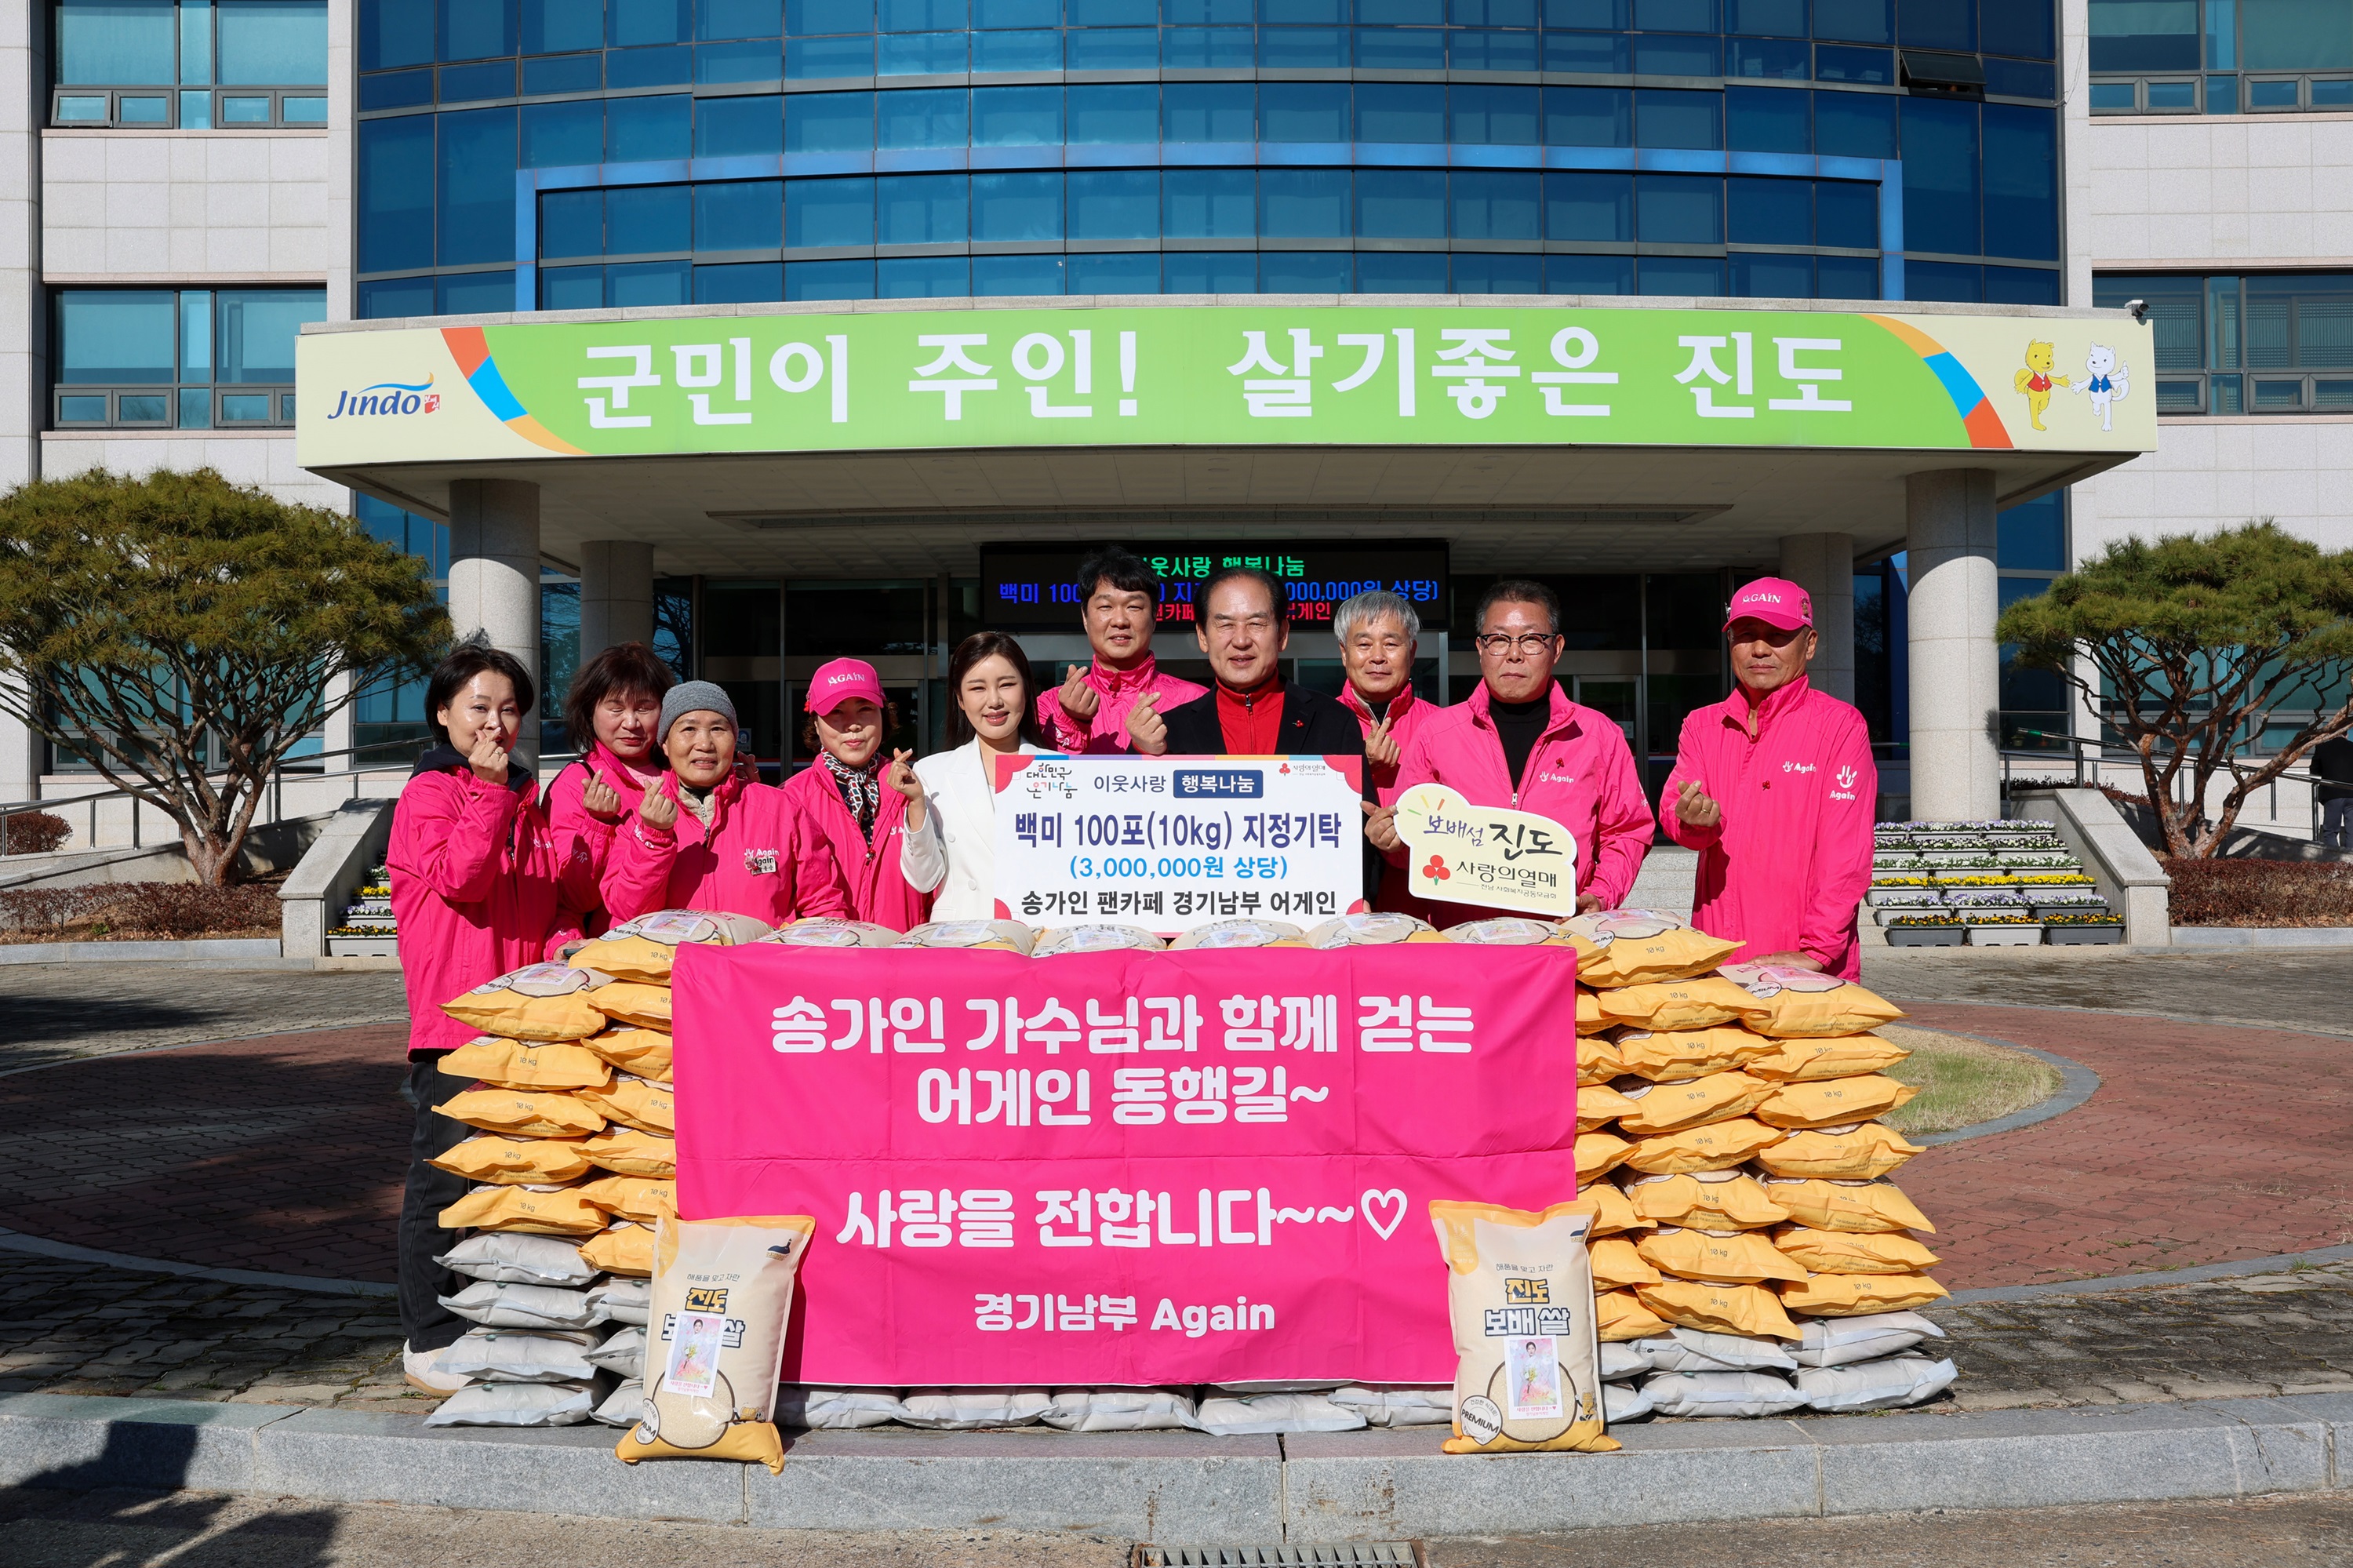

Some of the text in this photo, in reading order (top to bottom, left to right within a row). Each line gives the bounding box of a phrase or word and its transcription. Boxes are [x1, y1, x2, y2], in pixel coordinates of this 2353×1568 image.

[577, 326, 1852, 428] 군민이 주인! 살기좋은 진도
[327, 390, 420, 420] Jindo
[1150, 557, 1212, 578] 웃사랑
[999, 583, 1038, 603] 백미
[1742, 593, 1781, 604] AGAIN
[828, 672, 865, 686] AGAIN
[1026, 762, 1072, 780] 대한민국
[1794, 762, 1816, 773] Again
[1094, 773, 1255, 793] 이웃사랑 행복나눔
[1550, 773, 1574, 784] Again
[1026, 782, 1078, 799] 온기나눔
[1830, 791, 1856, 801] Again
[1015, 811, 1342, 849] 백미 100포(10kg) 지정기탁
[1423, 815, 1562, 860] 보배섬 진도
[1069, 856, 1288, 879] (3,000,000원 상당)
[1021, 891, 1336, 915] 송가인 팬카페 경기남부 어게인
[659, 952, 667, 961] kg
[1678, 991, 1688, 999] kg
[771, 994, 1475, 1054] 송가인 가수님과 함께 걷는
[528, 1057, 537, 1066] kg
[917, 1065, 1329, 1126] 어게인 동행길~
[1833, 1090, 1842, 1098] kg
[525, 1103, 533, 1111] kg
[659, 1101, 667, 1109] kg
[512, 1151, 522, 1160] kg
[659, 1189, 668, 1199] kg
[527, 1203, 535, 1213] kg
[836, 1188, 1016, 1248] 사랑을
[1719, 1249, 1728, 1257] kg
[1504, 1278, 1550, 1304] 진도
[1862, 1282, 1871, 1290] kg
[684, 1287, 729, 1314] 진도
[1719, 1299, 1728, 1308] kg
[973, 1293, 1275, 1339] 경기남부 Again
[1461, 1409, 1500, 1434] PREMIUM
